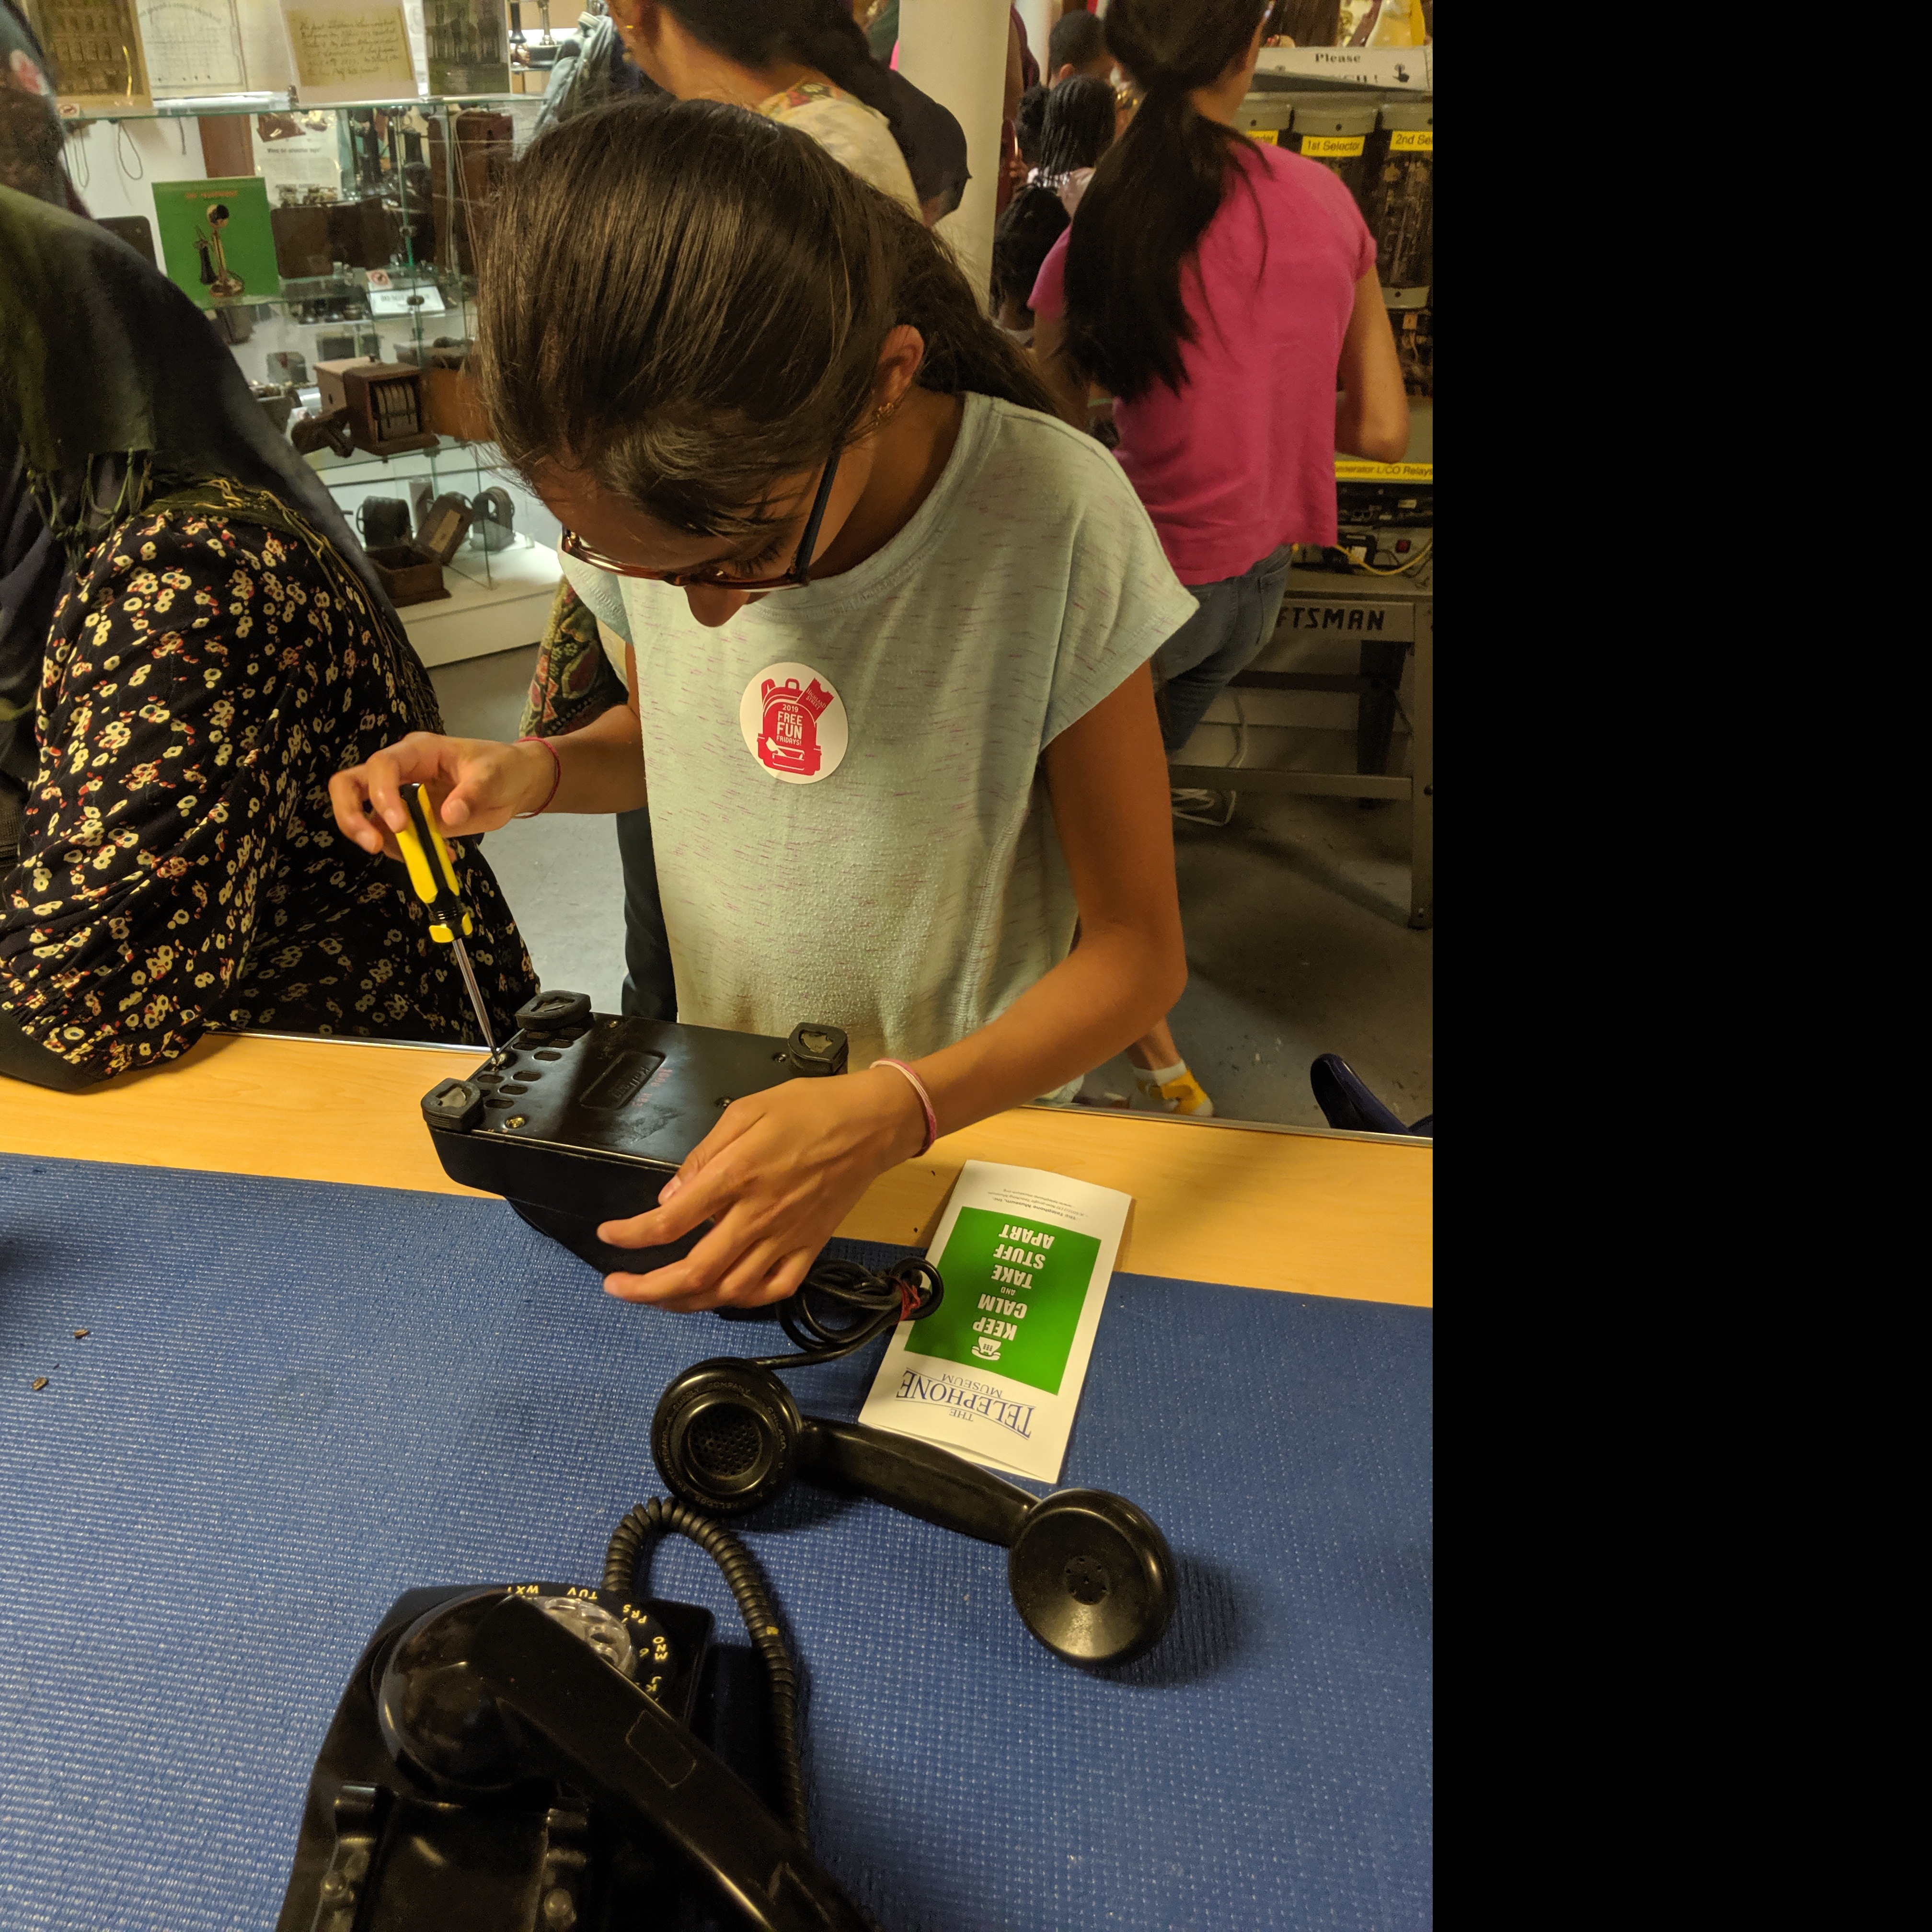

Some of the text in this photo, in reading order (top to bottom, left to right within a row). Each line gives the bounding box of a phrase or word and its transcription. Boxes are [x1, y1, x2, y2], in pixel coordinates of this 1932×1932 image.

[1315, 53, 1361, 63] Please
[1308, 140, 1360, 151] 1st Selector
[1396, 134, 1414, 145] 2nd
[1276, 606, 1385, 631] FTSMAN
[782, 704, 799, 713] 2019
[777, 711, 803, 726] FREE
[777, 722, 803, 739] FUN
[776, 735, 802, 746] FRIDAYS!
[1033, 1205, 1063, 1217] Telephone
[998, 1224, 1055, 1250] APART
[993, 1243, 1046, 1269] STUFF
[991, 1264, 1033, 1289] TAKE
[1000, 1286, 1016, 1296] AND
[978, 1293, 1028, 1319] CALM
[972, 1317, 1018, 1341] KEEP
[707, 1381, 751, 1394] COMPANY
[942, 1373, 1003, 1398] MUSEUM
[896, 1370, 1035, 1438] TELEPHONE
[949, 1408, 974, 1422] THE
[567, 1587, 598, 1599] TUV
[623, 1604, 647, 1623] PRS
[639, 1648, 649, 1657] 6
[653, 1636, 668, 1660] MNO
